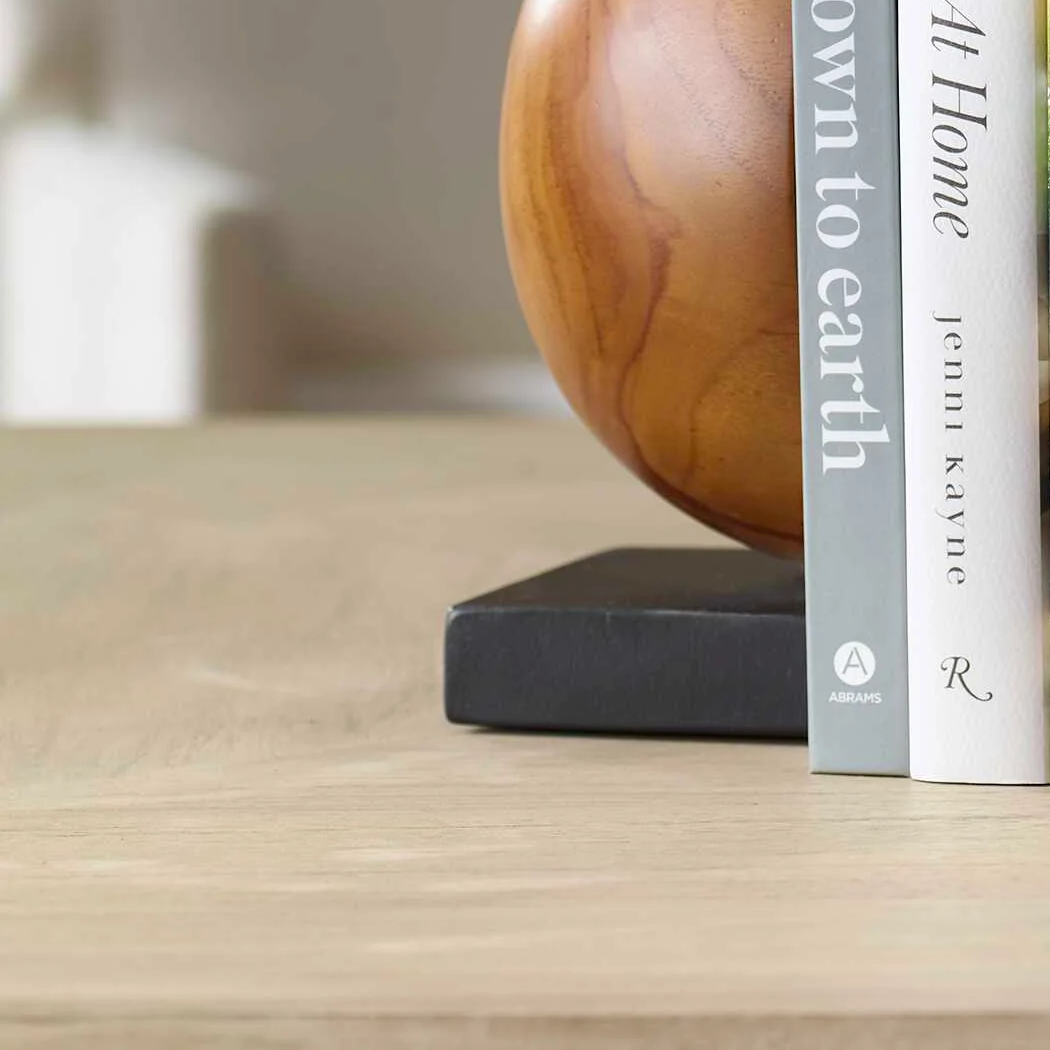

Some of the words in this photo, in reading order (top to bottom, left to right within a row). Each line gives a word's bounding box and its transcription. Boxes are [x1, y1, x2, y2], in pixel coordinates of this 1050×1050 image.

[814, 171, 876, 249] to
[931, 70, 988, 239] Home
[816, 268, 891, 477] earth
[828, 691, 883, 705] ABRAMS
